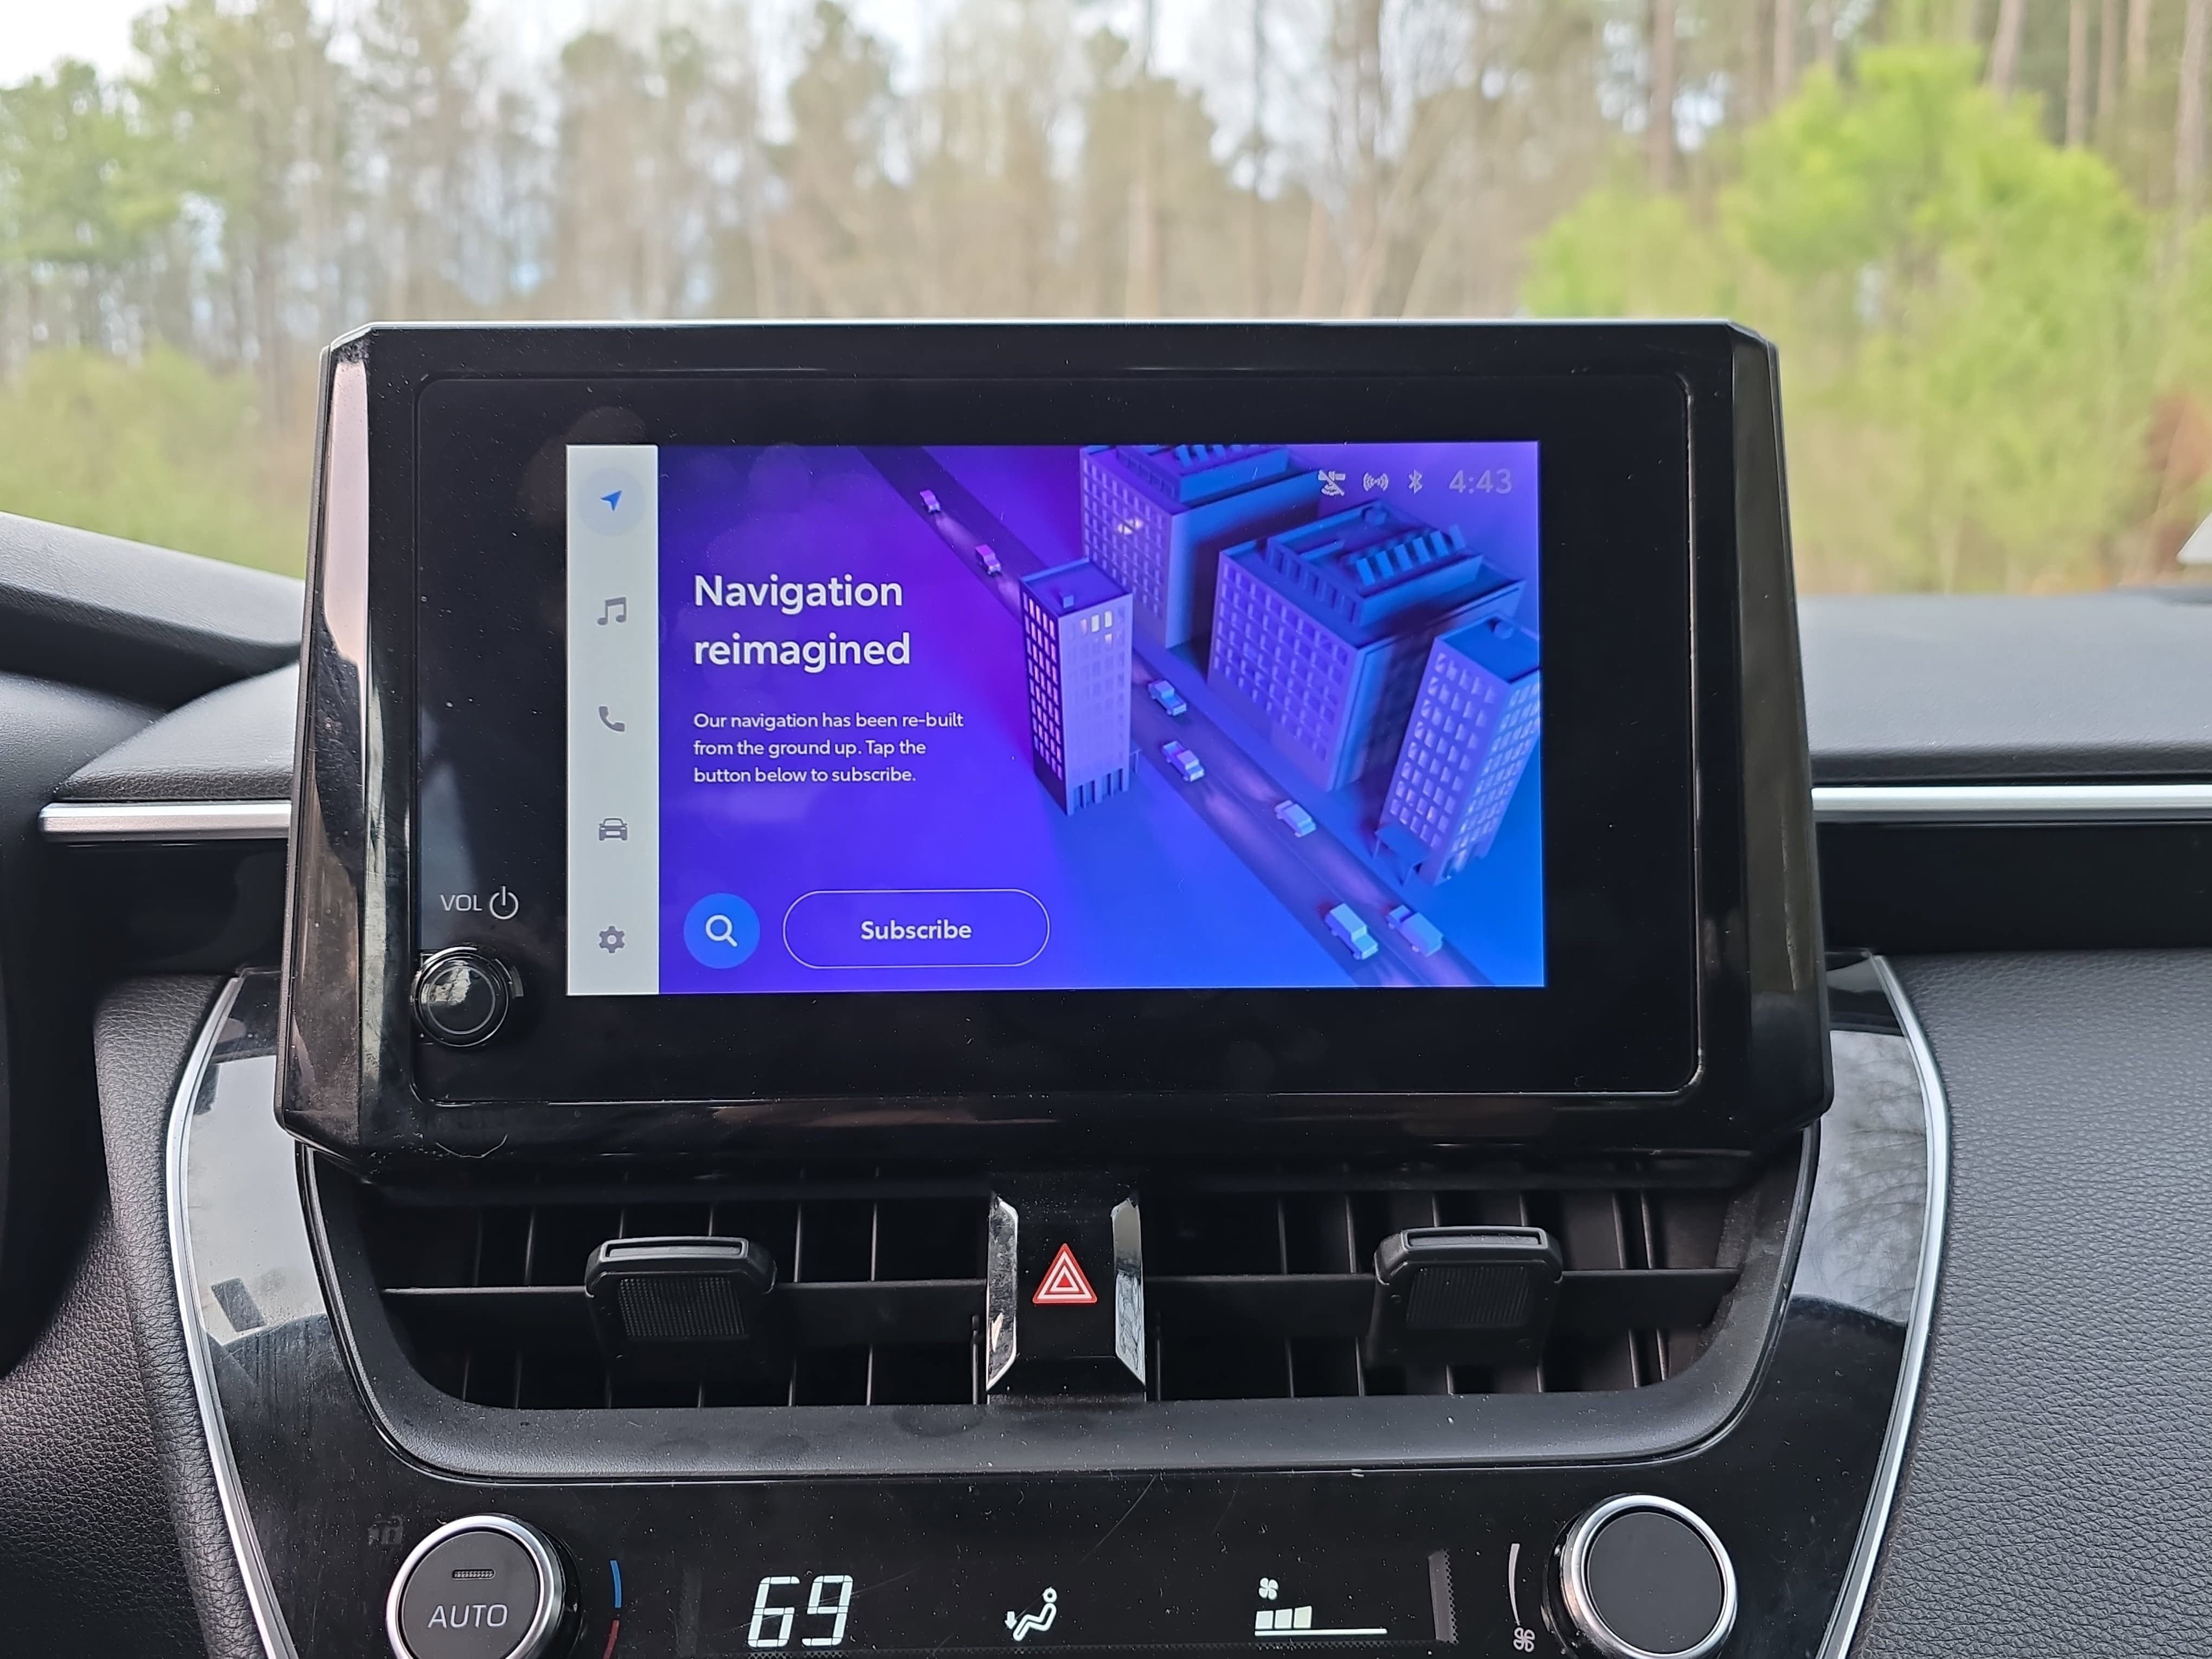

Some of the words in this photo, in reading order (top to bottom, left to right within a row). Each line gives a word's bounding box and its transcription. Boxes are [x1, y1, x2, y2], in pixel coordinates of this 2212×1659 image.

[1449, 468, 1513, 494] 4:43
[695, 574, 903, 615] Navigation
[695, 632, 910, 673] reimagined
[694, 713, 728, 728] Our
[731, 712, 818, 731] navigation
[822, 712, 851, 727] has
[856, 712, 897, 727] been
[903, 712, 964, 727] re-built
[693, 740, 734, 755] from
[737, 740, 764, 755] the
[768, 739, 830, 758] ground
[835, 744, 861, 758] up.
[865, 740, 895, 758] Tap
[899, 739, 926, 754] the
[694, 767, 751, 782] button
[755, 767, 807, 782] below
[811, 768, 828, 782] to
[832, 766, 916, 782] subscribe.
[440, 894, 483, 911] VOL
[860, 919, 972, 940] Subscribe
[427, 1603, 508, 1629] AUTO
[747, 1574, 854, 1648] 69
